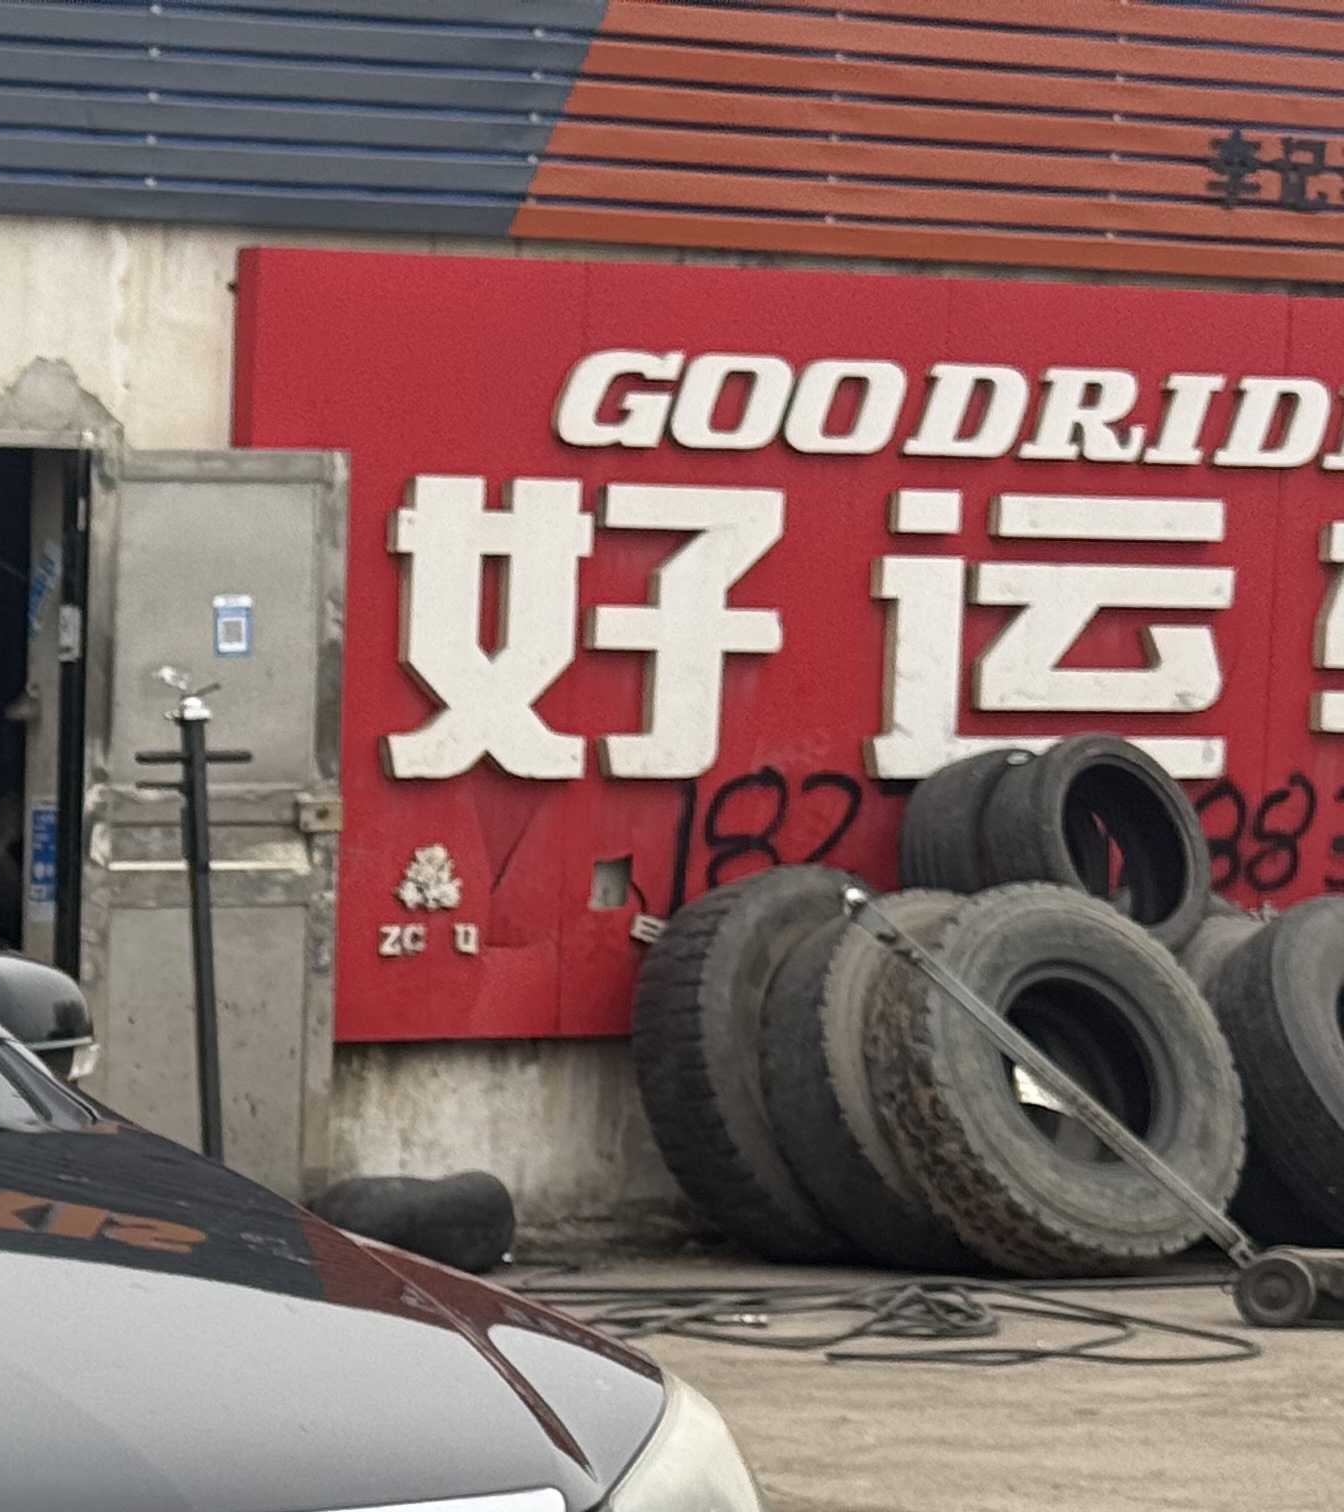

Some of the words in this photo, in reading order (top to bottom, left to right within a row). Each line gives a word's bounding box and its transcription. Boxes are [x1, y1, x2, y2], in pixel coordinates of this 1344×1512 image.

[1206, 128, 1344, 214] 李记
[380, 474, 1344, 780] 好运
[669, 765, 918, 918] 182
[1195, 771, 1344, 892] 88
[378, 924, 426, 956] ZC
